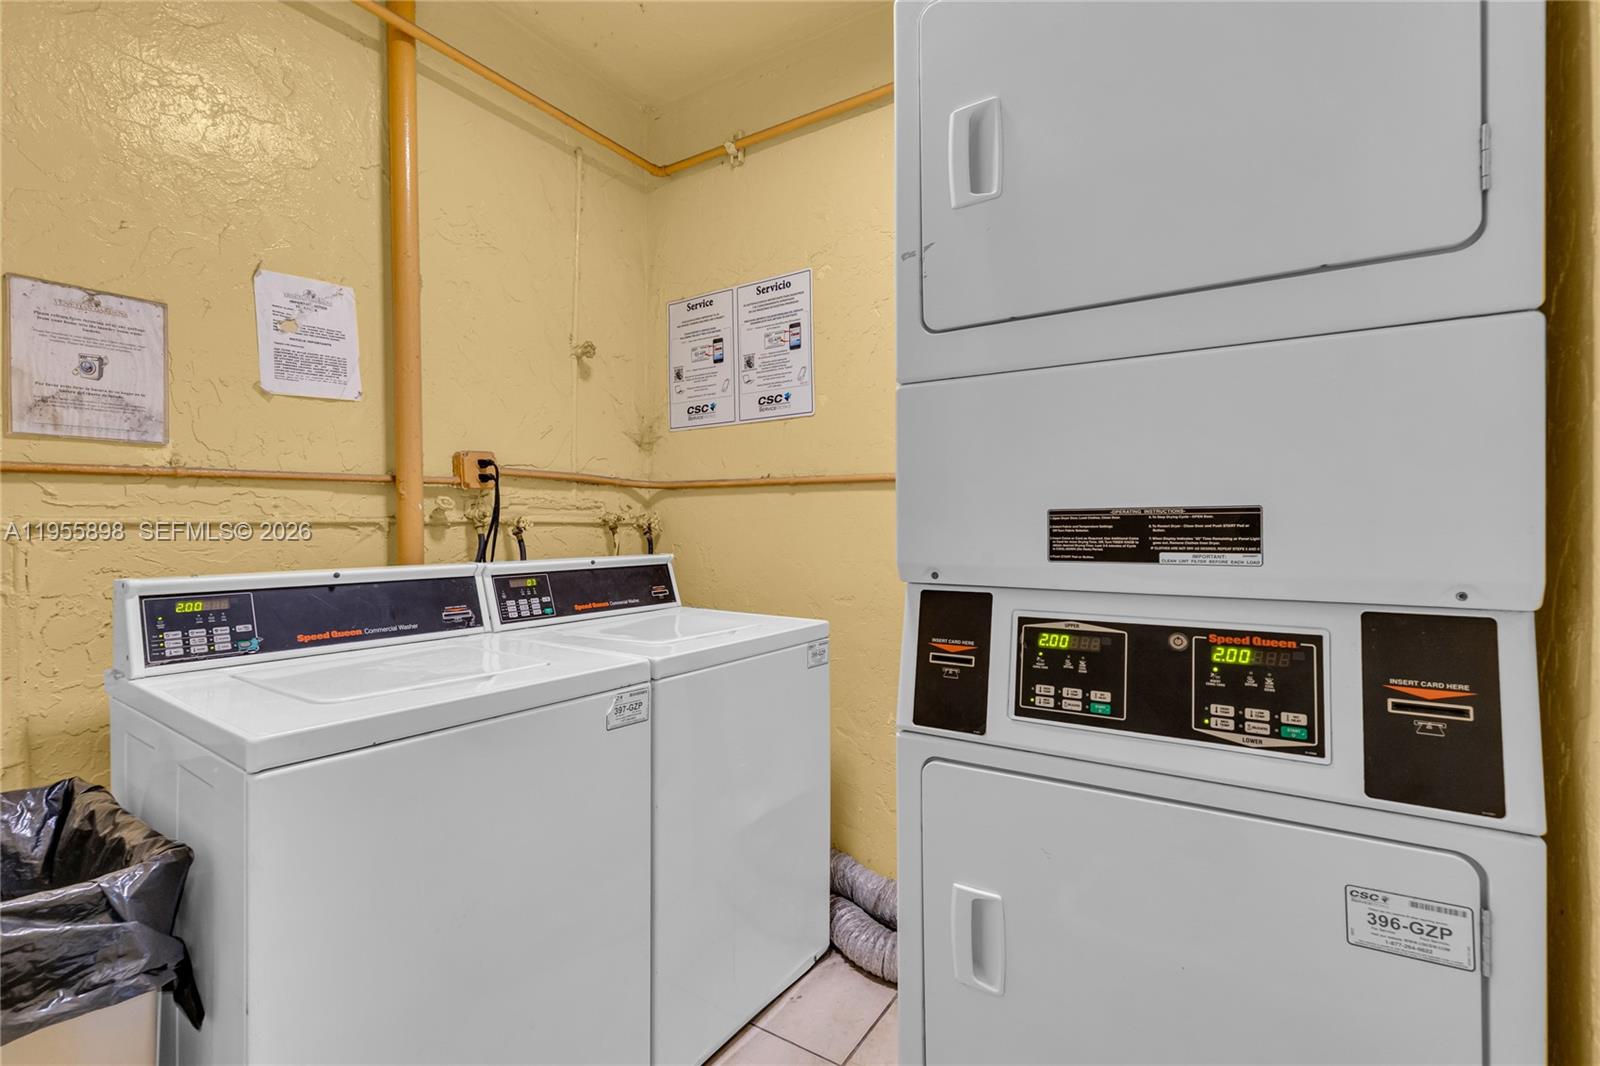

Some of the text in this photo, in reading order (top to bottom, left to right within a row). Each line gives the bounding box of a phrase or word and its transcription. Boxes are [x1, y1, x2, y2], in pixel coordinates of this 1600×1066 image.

[756, 280, 791, 296] Servicio
[686, 299, 714, 312] Service
[758, 394, 782, 406] CSC
[687, 404, 709, 414] CSC
[176, 602, 202, 612] 2.00
[297, 623, 418, 643] Speed Queen Commercial Washer
[1039, 633, 1069, 648] 2.00
[1208, 634, 1297, 648] Speed Queen
[1212, 647, 1251, 664] 2.00
[1389, 678, 1419, 686] INSERT
[1420, 681, 1445, 689] CARD
[1242, 737, 1263, 745] LOWER
[1350, 890, 1379, 901] CSC
[1367, 912, 1453, 940] 396-GZP
